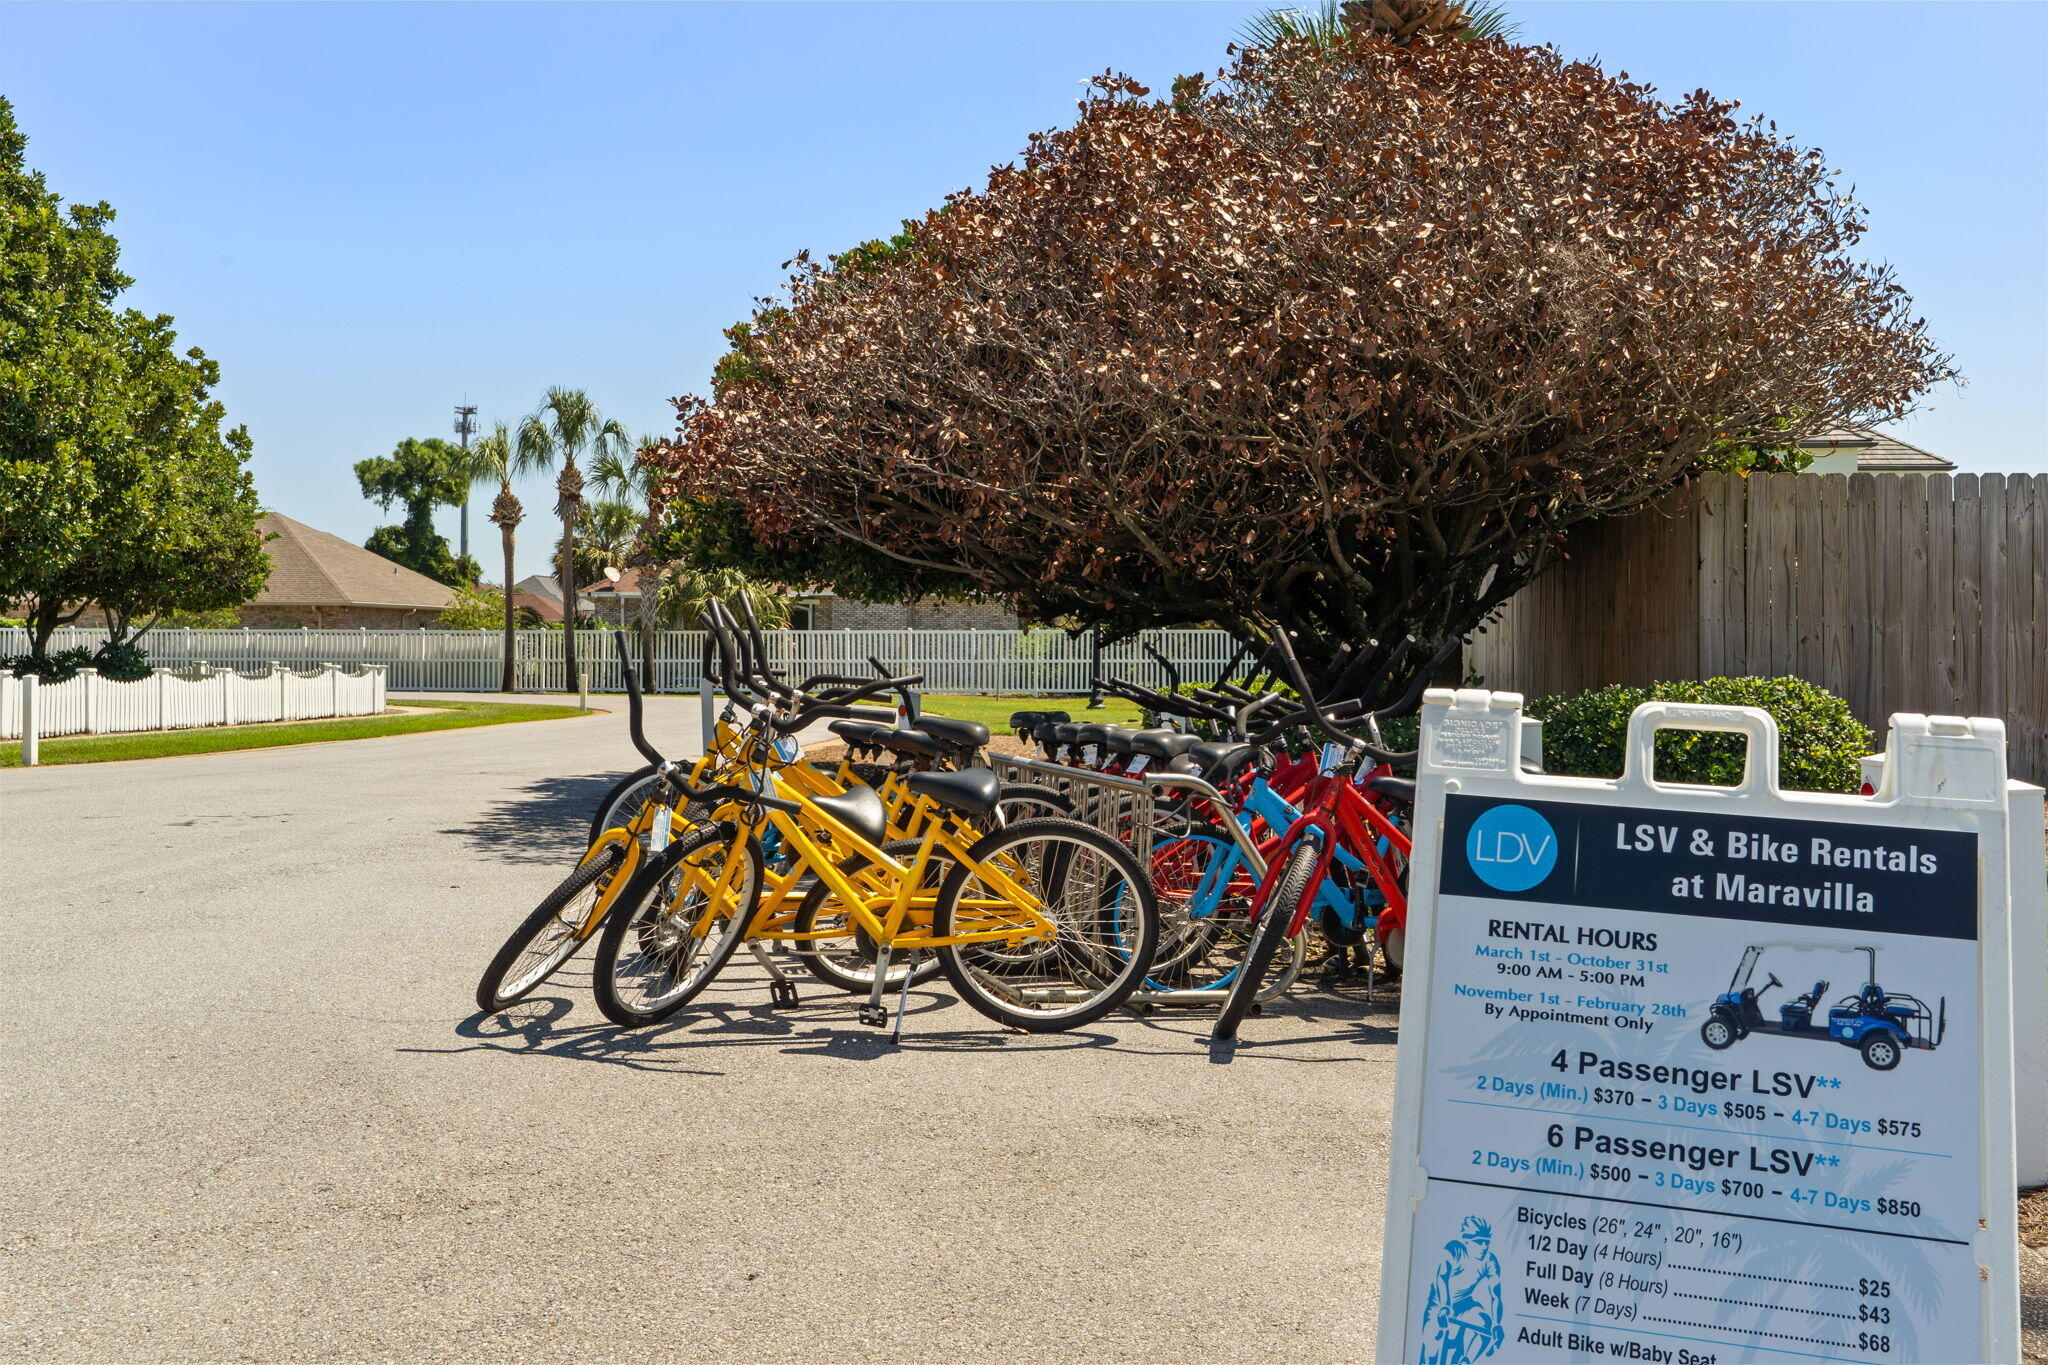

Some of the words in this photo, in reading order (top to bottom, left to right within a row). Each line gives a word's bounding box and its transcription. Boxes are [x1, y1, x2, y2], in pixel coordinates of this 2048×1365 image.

[1475, 830, 1551, 866] LDV
[1616, 822, 1678, 854] LSV
[1689, 828, 1715, 857] &
[1727, 832, 1799, 864] Bike
[1811, 837, 1937, 875] Rentals
[1671, 874, 1704, 898] at
[1716, 873, 1874, 913] Maravilla
[1488, 919, 1570, 944] RENTAL
[1577, 927, 1658, 951] HOURS
[1475, 944, 1523, 960] March
[1530, 950, 1550, 963] 1st
[1567, 952, 1631, 970] October
[1637, 960, 1669, 973] 31st
[1497, 963, 1530, 977] 9:00
[1536, 966, 1562, 980] AM
[1580, 970, 1614, 984] 5:00
[1620, 974, 1645, 987] PM
[1454, 984, 1533, 1002] November
[1539, 992, 1560, 1006] 1st
[1577, 995, 1645, 1017] February
[1651, 1002, 1687, 1018] 28th
[1484, 1002, 1504, 1019] By
[1508, 1005, 1610, 1027] Appointment
[1615, 1016, 1654, 1034] Only
[1551, 1049, 1568, 1073] 4
[1578, 1051, 1742, 1094] Passenger
[1476, 1075, 1487, 1090] 2
[1492, 1077, 1534, 1098] Days
[1540, 1082, 1588, 1104] (Min.)
[1594, 1087, 1634, 1106] $370
[1658, 1095, 1668, 1110] 3
[1674, 1096, 1718, 1117] Days
[1724, 1102, 1766, 1121] $505
[1792, 1110, 1820, 1125] 4-7
[1826, 1113, 1872, 1135] Days
[1877, 1118, 1922, 1138] $575
[1547, 1123, 1564, 1148] 6
[1574, 1126, 1740, 1171] Passenger
[1472, 1150, 1482, 1165] 2
[1487, 1151, 1530, 1173] Days
[1536, 1156, 1584, 1181] (Min.)
[1590, 1163, 1631, 1183] $500
[1654, 1171, 1665, 1187] 3
[1671, 1172, 1716, 1194] Days
[1722, 1178, 1764, 1199] $700
[1790, 1188, 1818, 1204] 4-7
[1824, 1192, 1870, 1214] Days
[1877, 1197, 1920, 1218] $850
[1518, 1206, 1587, 1231] Bicycles
[1528, 1234, 1551, 1252] 1/2
[1557, 1238, 1588, 1260] Day
[1593, 1243, 1608, 1262] (4
[1612, 1246, 1662, 1269] Hours)
[1859, 1278, 1890, 1298] $25
[1526, 1261, 1556, 1280] Full
[1562, 1265, 1594, 1289] Day
[1599, 1271, 1614, 1290] (8
[1618, 1274, 1668, 1298] Hours)
[1859, 1304, 1890, 1324] $43
[1524, 1287, 1570, 1310] Week
[1575, 1295, 1590, 1314] (7
[1594, 1298, 1638, 1322] Days)
[1859, 1332, 1890, 1353] $68
[1517, 1326, 1563, 1349] Adult
[1568, 1334, 1605, 1354] Bike
[1610, 1340, 1672, 1365] w/Baby
[1678, 1348, 1717, 1365] Seat
